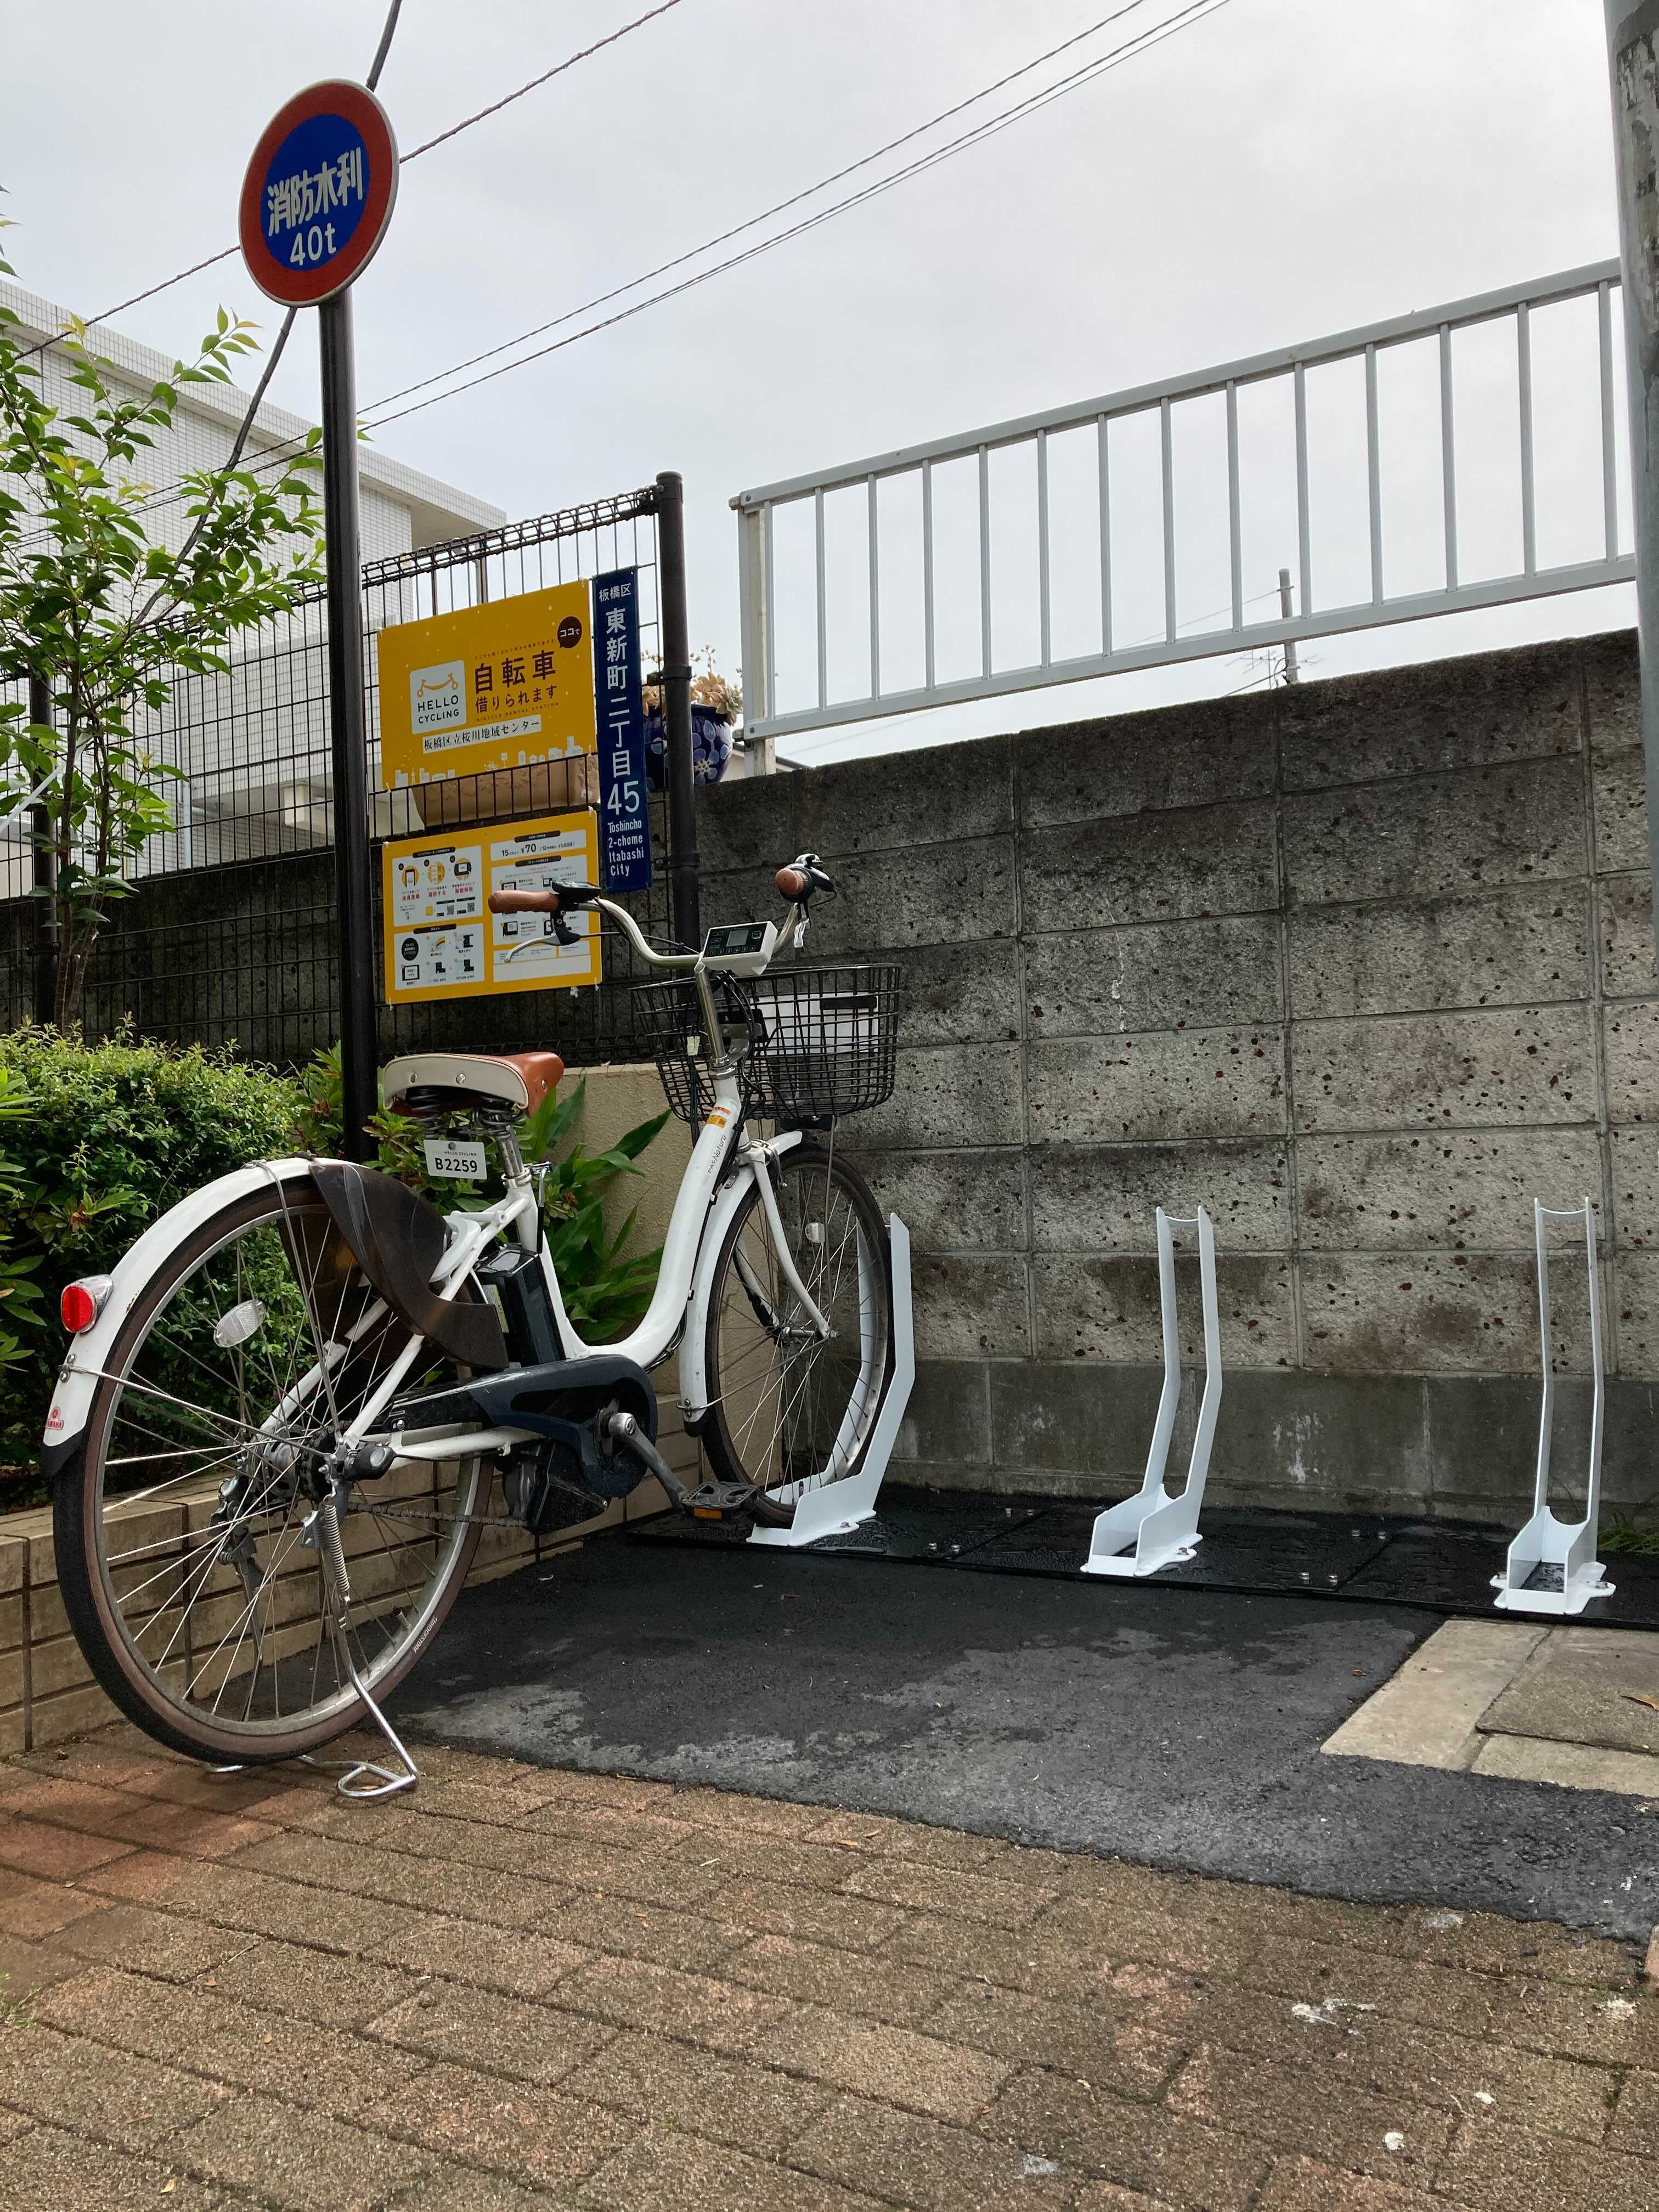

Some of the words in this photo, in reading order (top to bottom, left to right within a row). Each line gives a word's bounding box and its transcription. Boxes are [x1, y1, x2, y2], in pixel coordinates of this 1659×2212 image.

[267, 146, 363, 236] 消防水利
[290, 222, 336, 266] 40t
[599, 583, 632, 603] 板橋区
[560, 627, 580, 637] ココで
[475, 649, 556, 695] 自転車
[475, 684, 558, 714] 借りられます
[605, 607, 631, 778] 東新町二丁目
[417, 695, 459, 713] HELLO
[418, 709, 460, 724] CYCLING
[424, 719, 540, 751] 板橋区立桜川地域センター
[607, 780, 640, 816] 45
[607, 818, 642, 833] Toshincho
[608, 833, 644, 848] 2-chome
[609, 847, 645, 863] Itabashi
[610, 863, 630, 877] City
[435, 1158, 478, 1173] B2259
